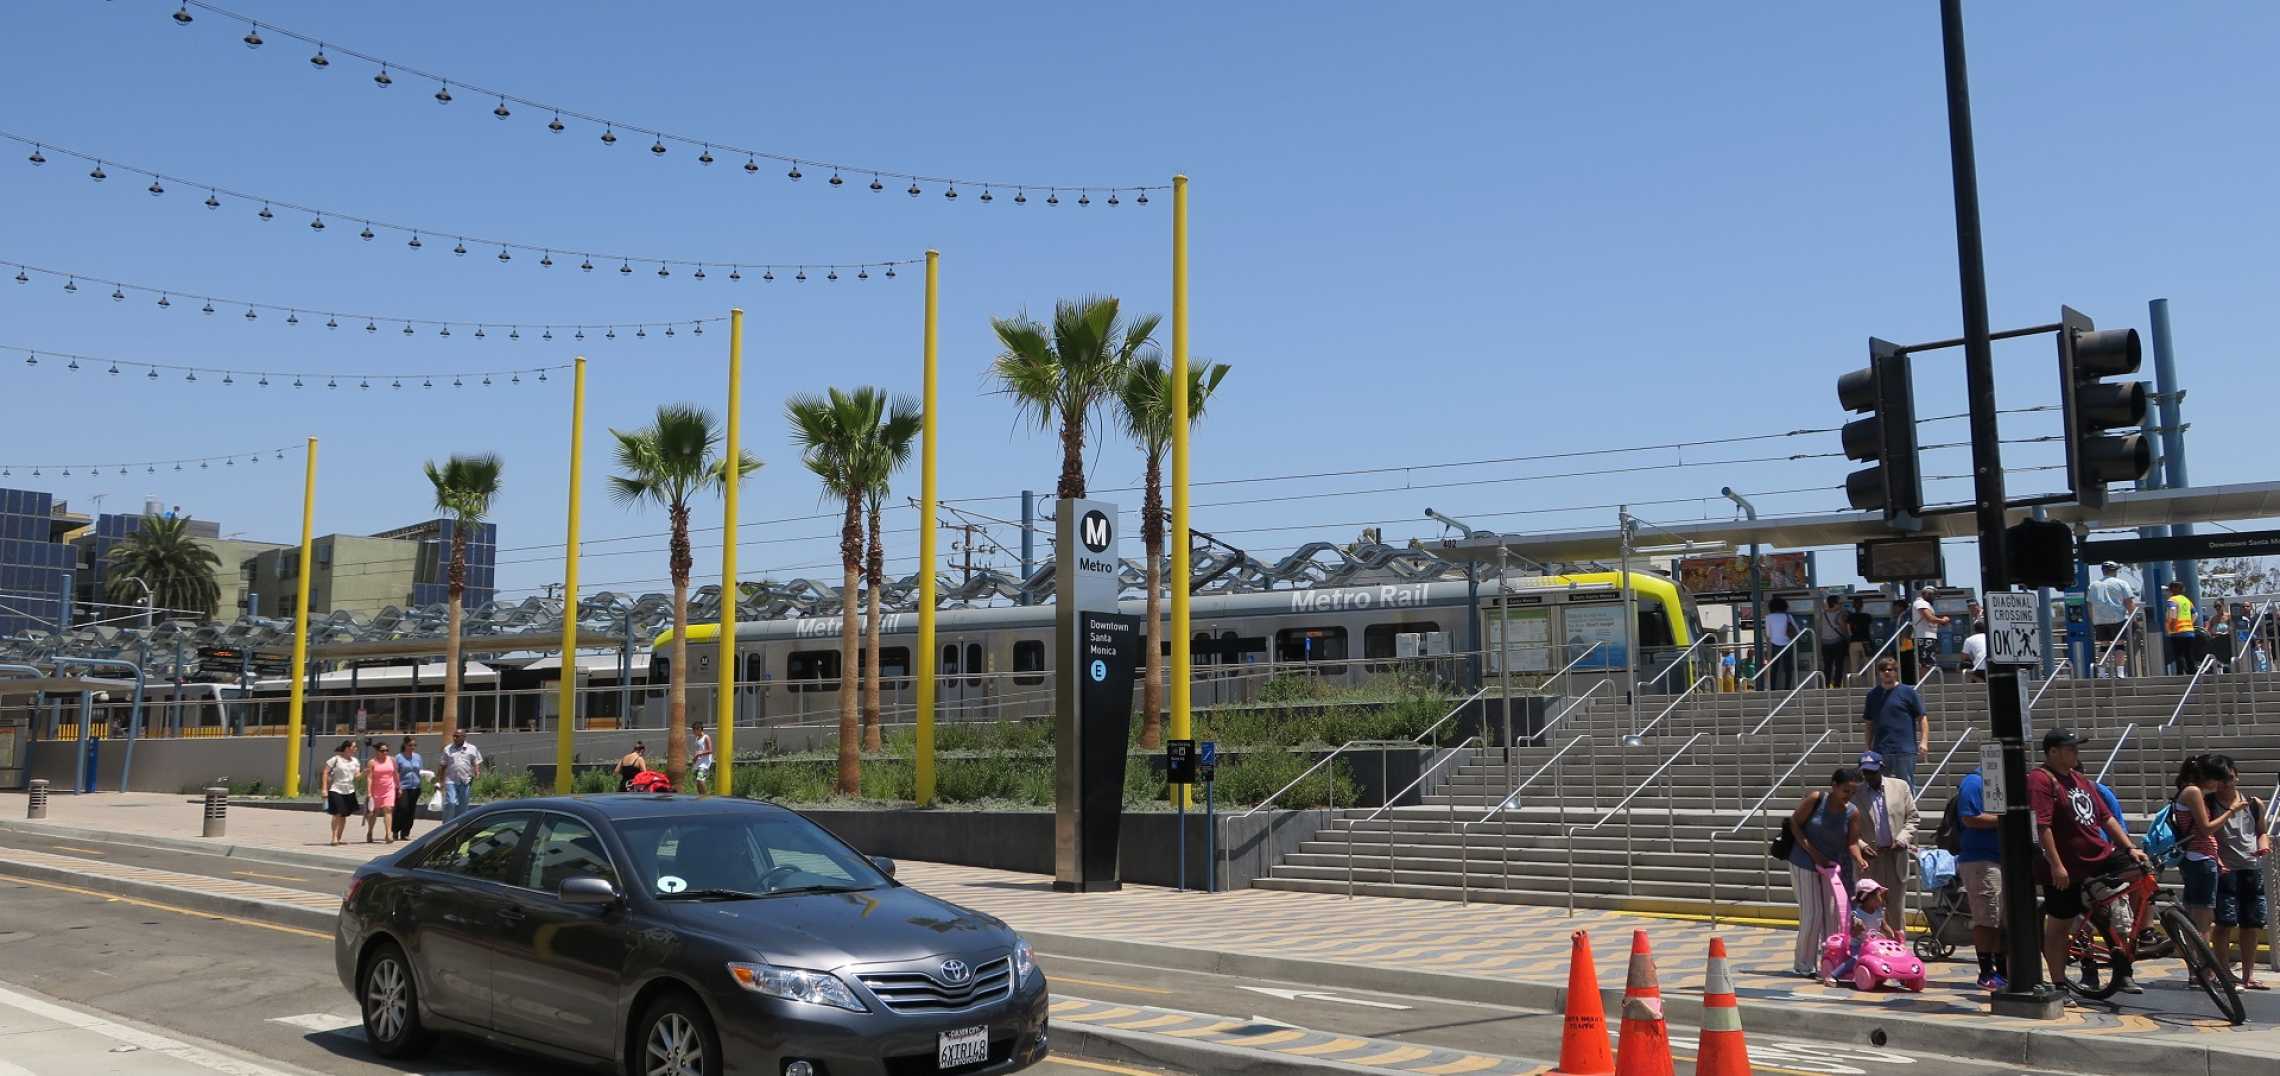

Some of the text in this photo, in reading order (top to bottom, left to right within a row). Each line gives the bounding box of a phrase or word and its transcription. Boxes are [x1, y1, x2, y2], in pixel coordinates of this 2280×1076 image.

[1086, 517, 1107, 546] M
[1080, 557, 1113, 574] Metro
[1291, 582, 1430, 612] Metro Rail
[1993, 595, 2033, 609] DIAGONAL
[1994, 609, 2033, 621] CROSSING
[796, 616, 844, 638] Metr
[1090, 619, 1129, 632] Downtown
[1090, 632, 1112, 643] Santa
[1993, 629, 2012, 655] OK
[1090, 644, 1117, 656] Monica
[942, 1039, 987, 1064] 6XTR148
